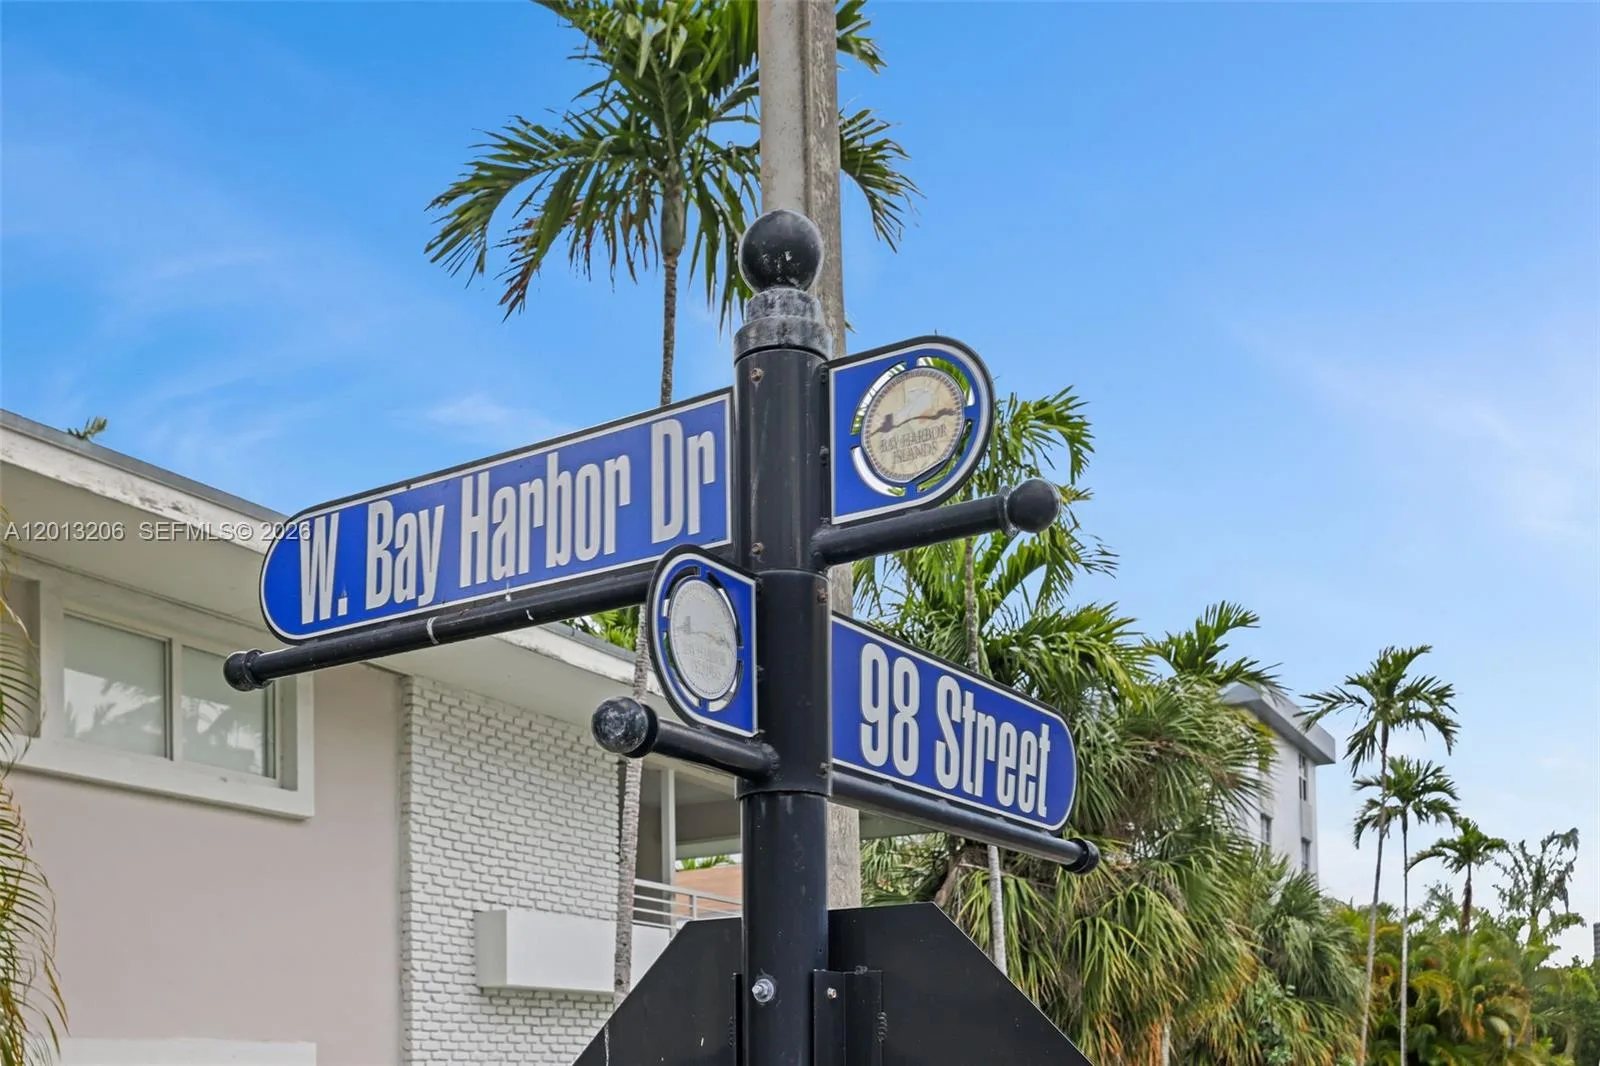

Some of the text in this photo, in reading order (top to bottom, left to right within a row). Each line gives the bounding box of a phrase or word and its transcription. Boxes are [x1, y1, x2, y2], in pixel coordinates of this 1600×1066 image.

[301, 418, 716, 625] W. Bay Harbor Dr
[860, 643, 1051, 818] 98 Street
